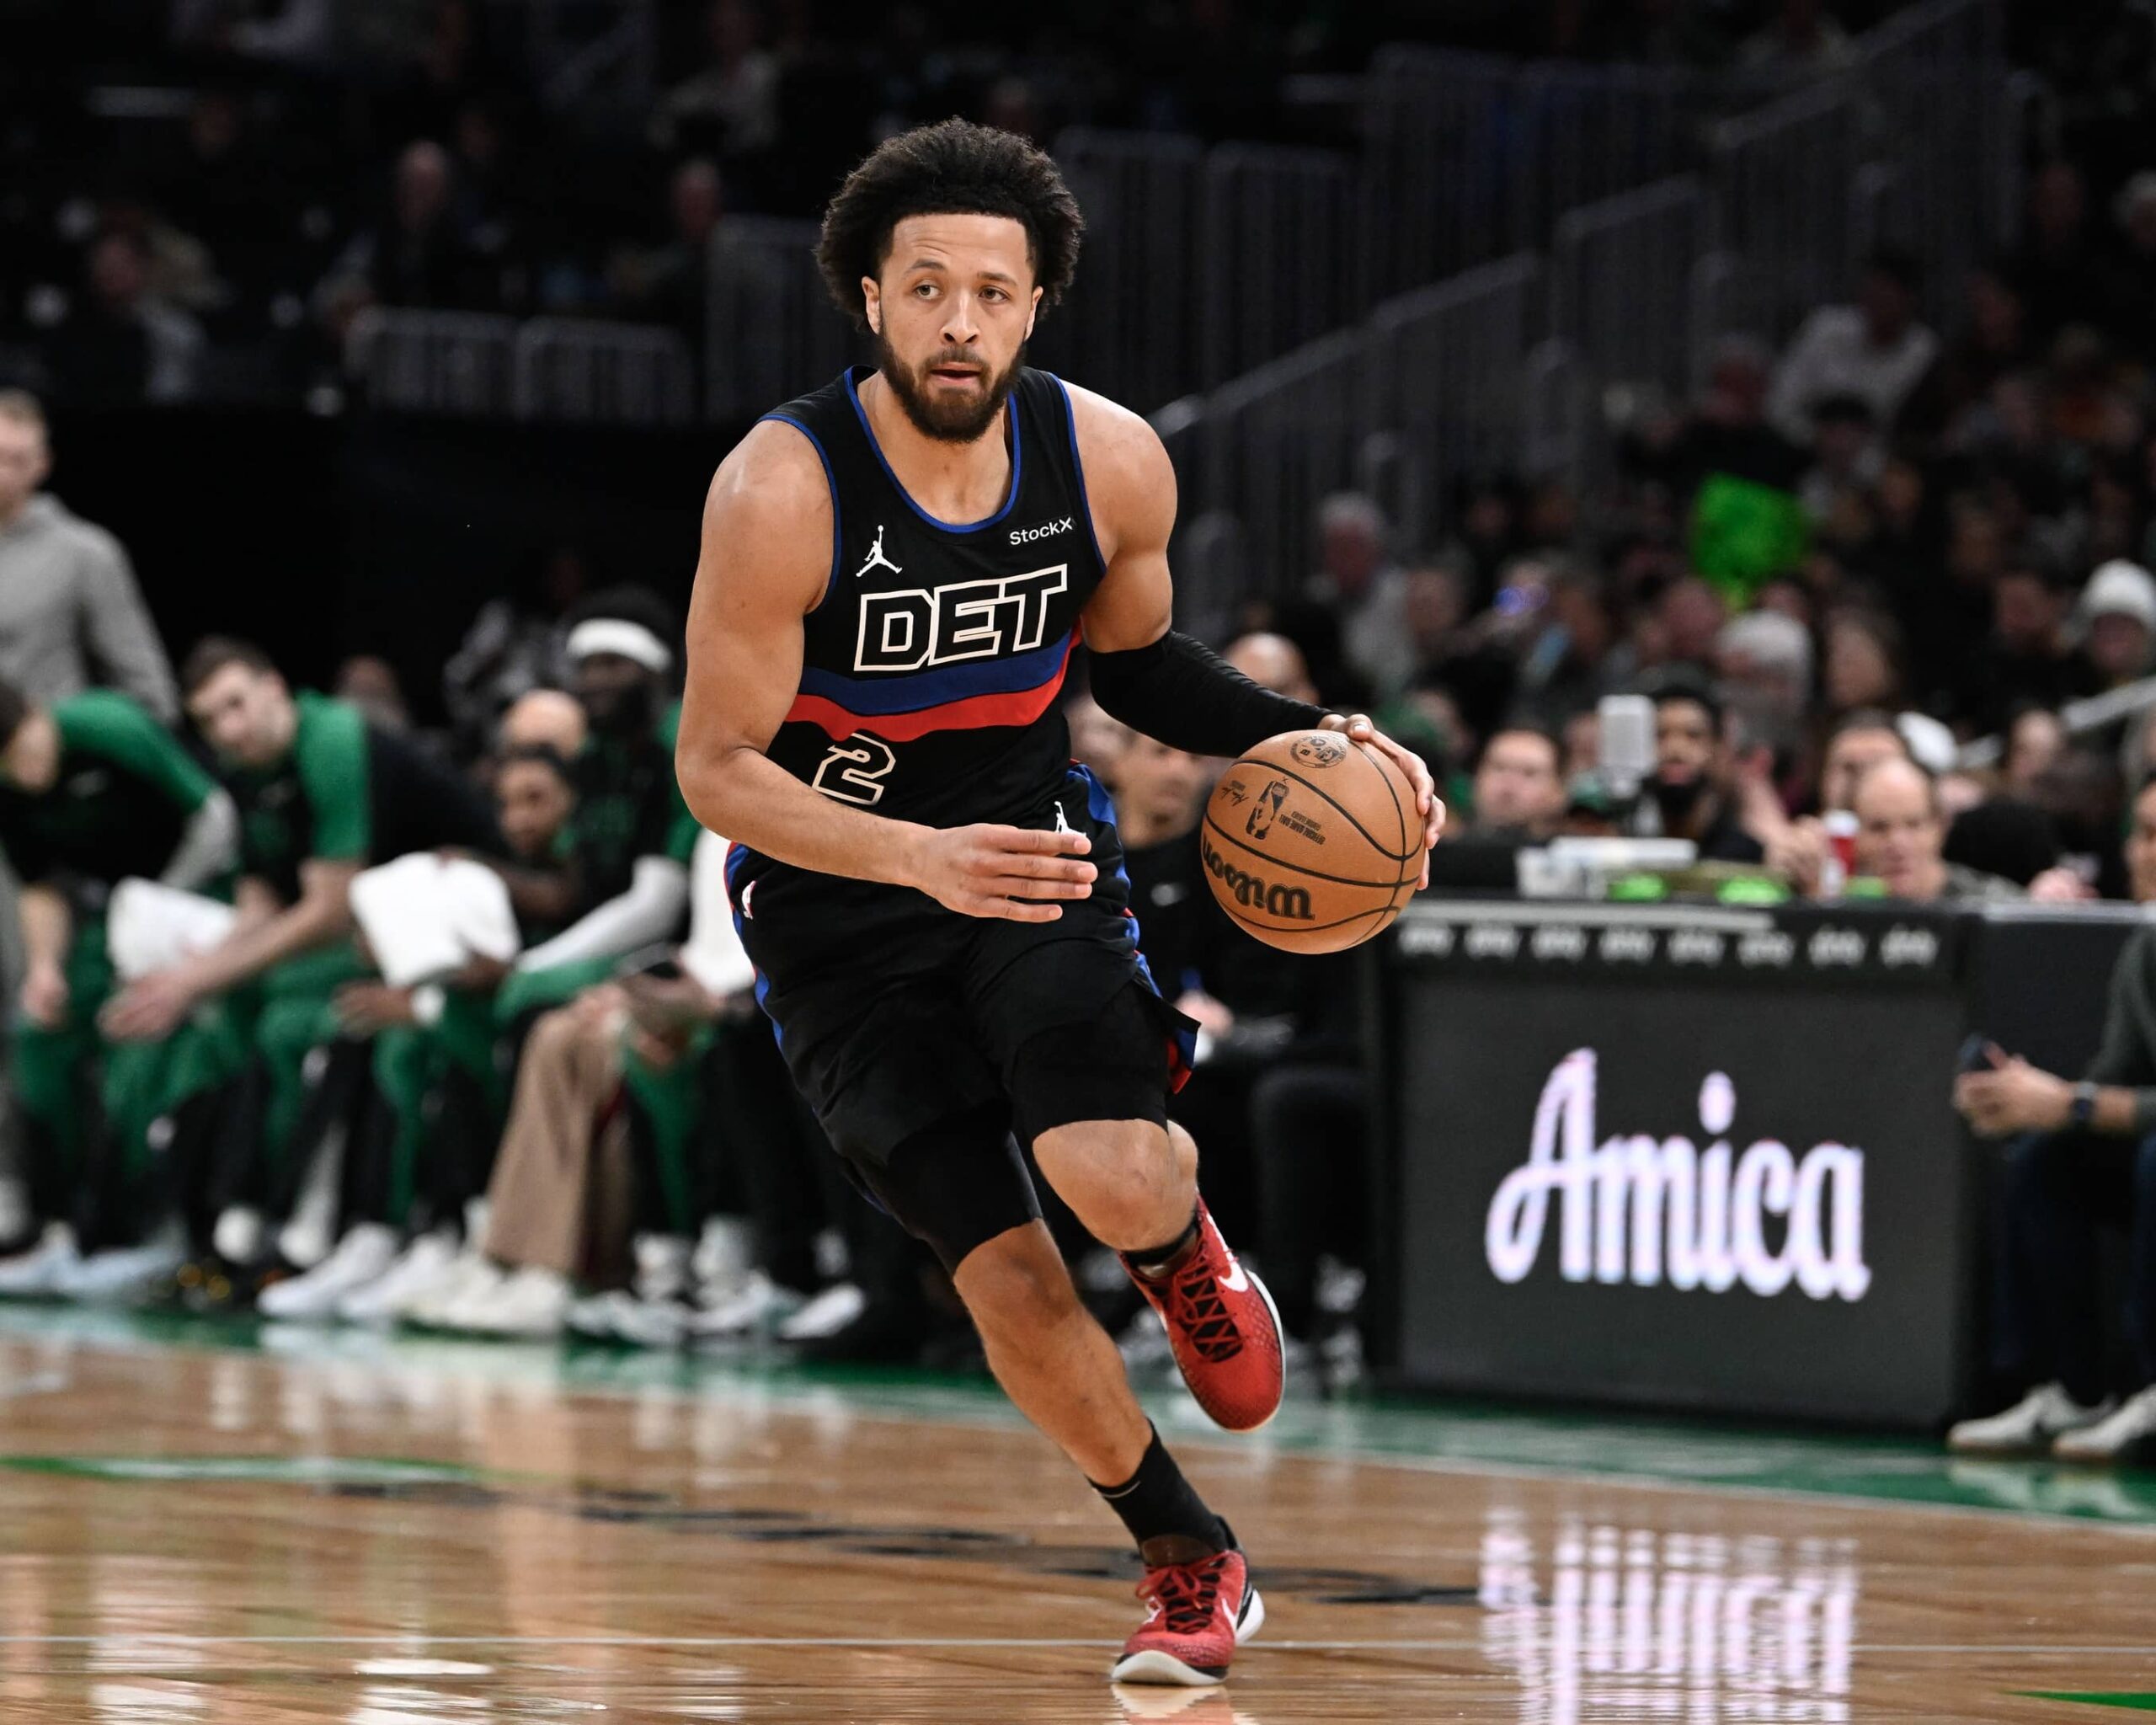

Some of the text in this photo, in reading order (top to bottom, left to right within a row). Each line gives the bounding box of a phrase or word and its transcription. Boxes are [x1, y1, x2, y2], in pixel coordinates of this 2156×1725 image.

[1010, 516, 1073, 545] StockX
[853, 563, 1068, 672] DET
[811, 731, 897, 805] 2
[1202, 832, 1315, 921] Wilson
[1485, 1046, 1872, 1303] Amica
